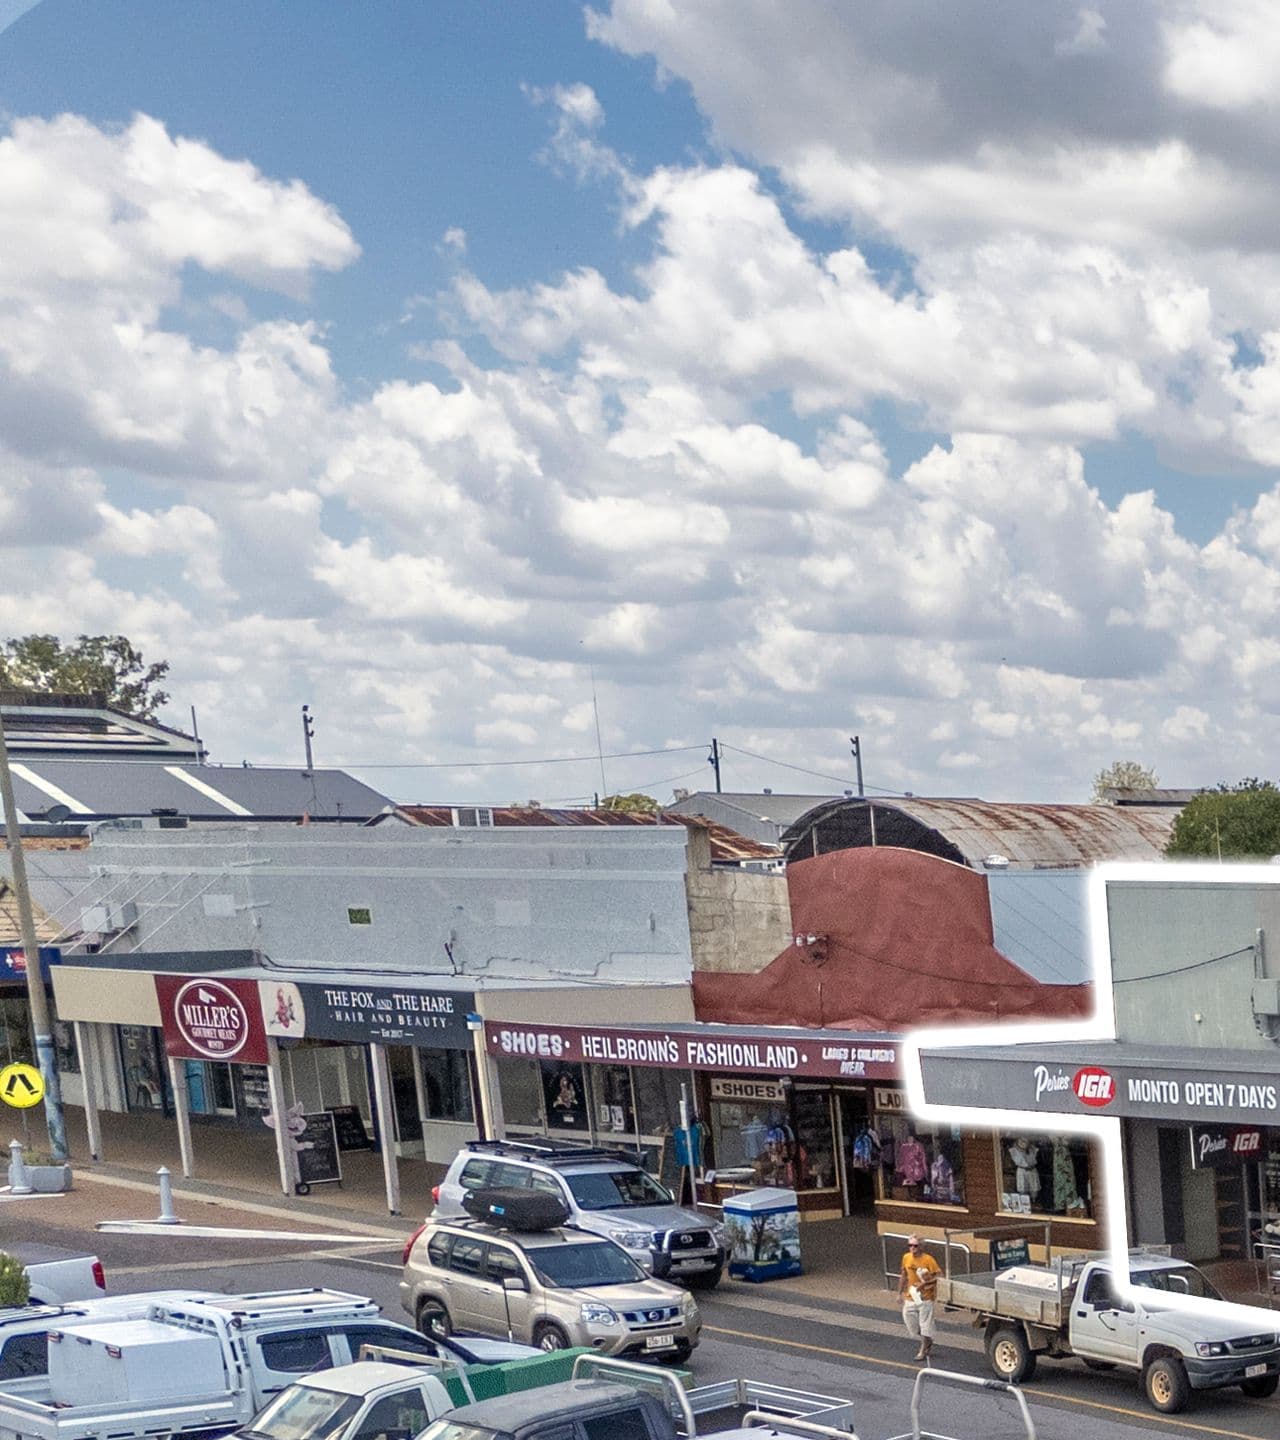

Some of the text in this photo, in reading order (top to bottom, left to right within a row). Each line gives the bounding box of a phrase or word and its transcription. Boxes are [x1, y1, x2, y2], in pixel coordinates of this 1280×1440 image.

[325, 989, 454, 1013] THE FOX AND THE HARE
[182, 1004, 240, 1029] MILLER'S
[335, 1010, 447, 1028] HAIR AND BEAUTY
[500, 1030, 563, 1057] SHOES
[581, 1035, 799, 1069] HEILBRONN'S FASHIONLAND
[822, 1047, 849, 1060] LADIES
[840, 1061, 865, 1076] WEAR
[722, 1082, 777, 1099] SHOES
[1033, 1065, 1112, 1102] Peries IGA
[1128, 1079, 1277, 1110] MONTO OPEN 7 DAYS
[1199, 1132, 1260, 1162] Peries IGA
